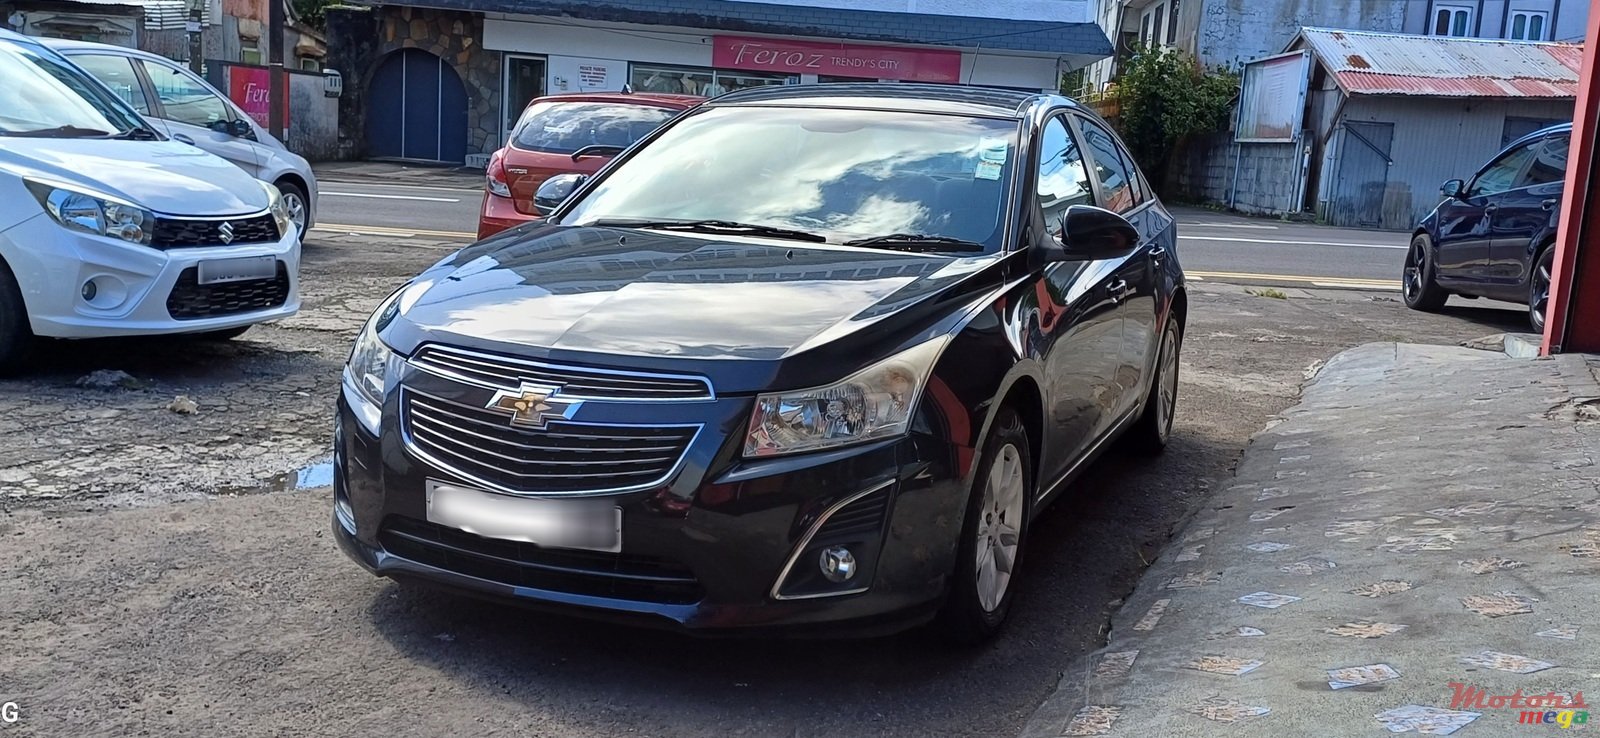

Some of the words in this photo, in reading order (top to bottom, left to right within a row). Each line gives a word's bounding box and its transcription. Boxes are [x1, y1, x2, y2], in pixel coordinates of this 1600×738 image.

[730, 43, 824, 67] Feroz
[831, 56, 876, 68] TRENDY'S
[878, 60, 899, 70] CITY
[243, 82, 270, 104] Fero
